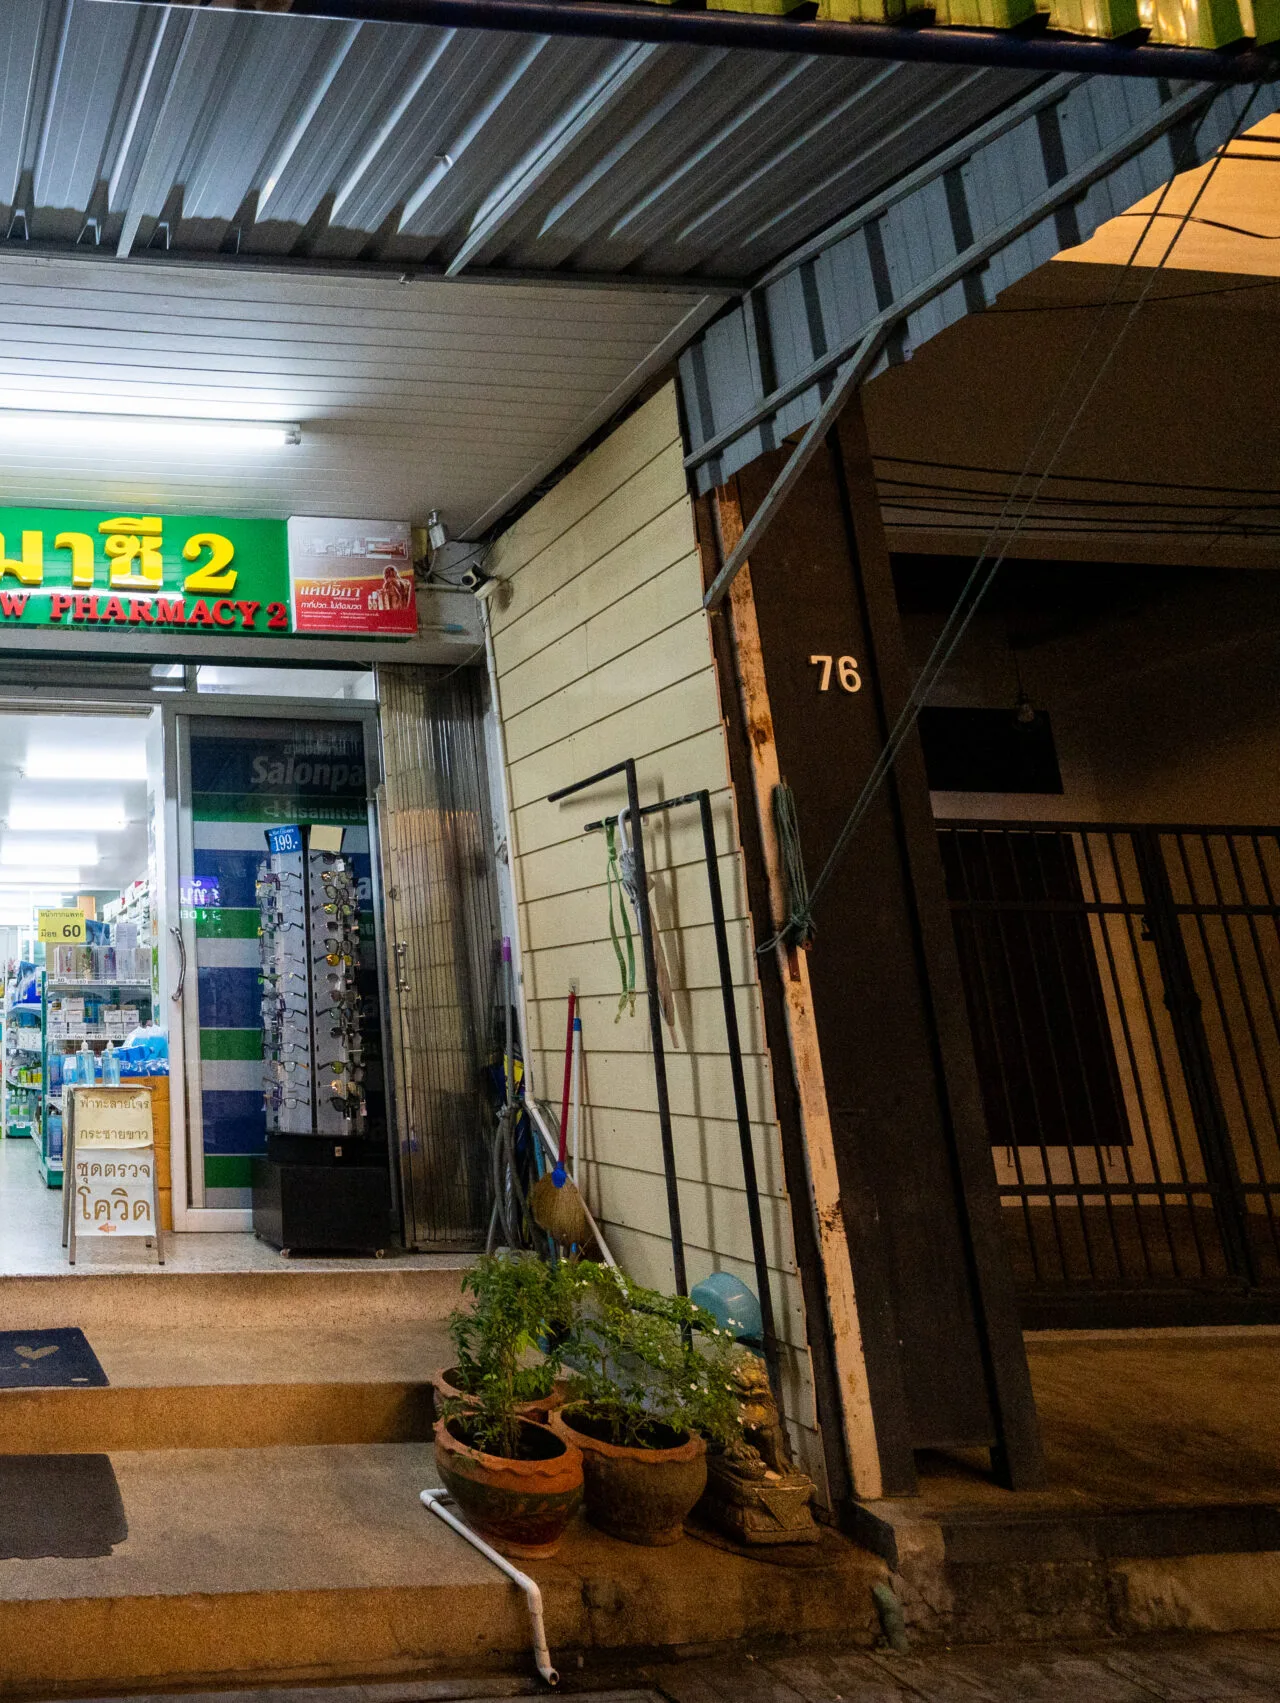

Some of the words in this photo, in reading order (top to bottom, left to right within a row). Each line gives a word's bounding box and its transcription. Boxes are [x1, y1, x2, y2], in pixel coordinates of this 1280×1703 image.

[182, 532, 238, 594] 2
[51, 594, 261, 627] PHARMACY
[266, 602, 289, 629] 2
[810, 654, 862, 693] 76
[250, 755, 365, 793] Salonpa
[62, 924, 81, 938] 60
[80, 1095, 150, 1110] ฟ้าทะลายโจร
[79, 1128, 149, 1141] กระชายขาว
[77, 1161, 151, 1184] ชุดตรวจ
[77, 1185, 151, 1221] โควิด
